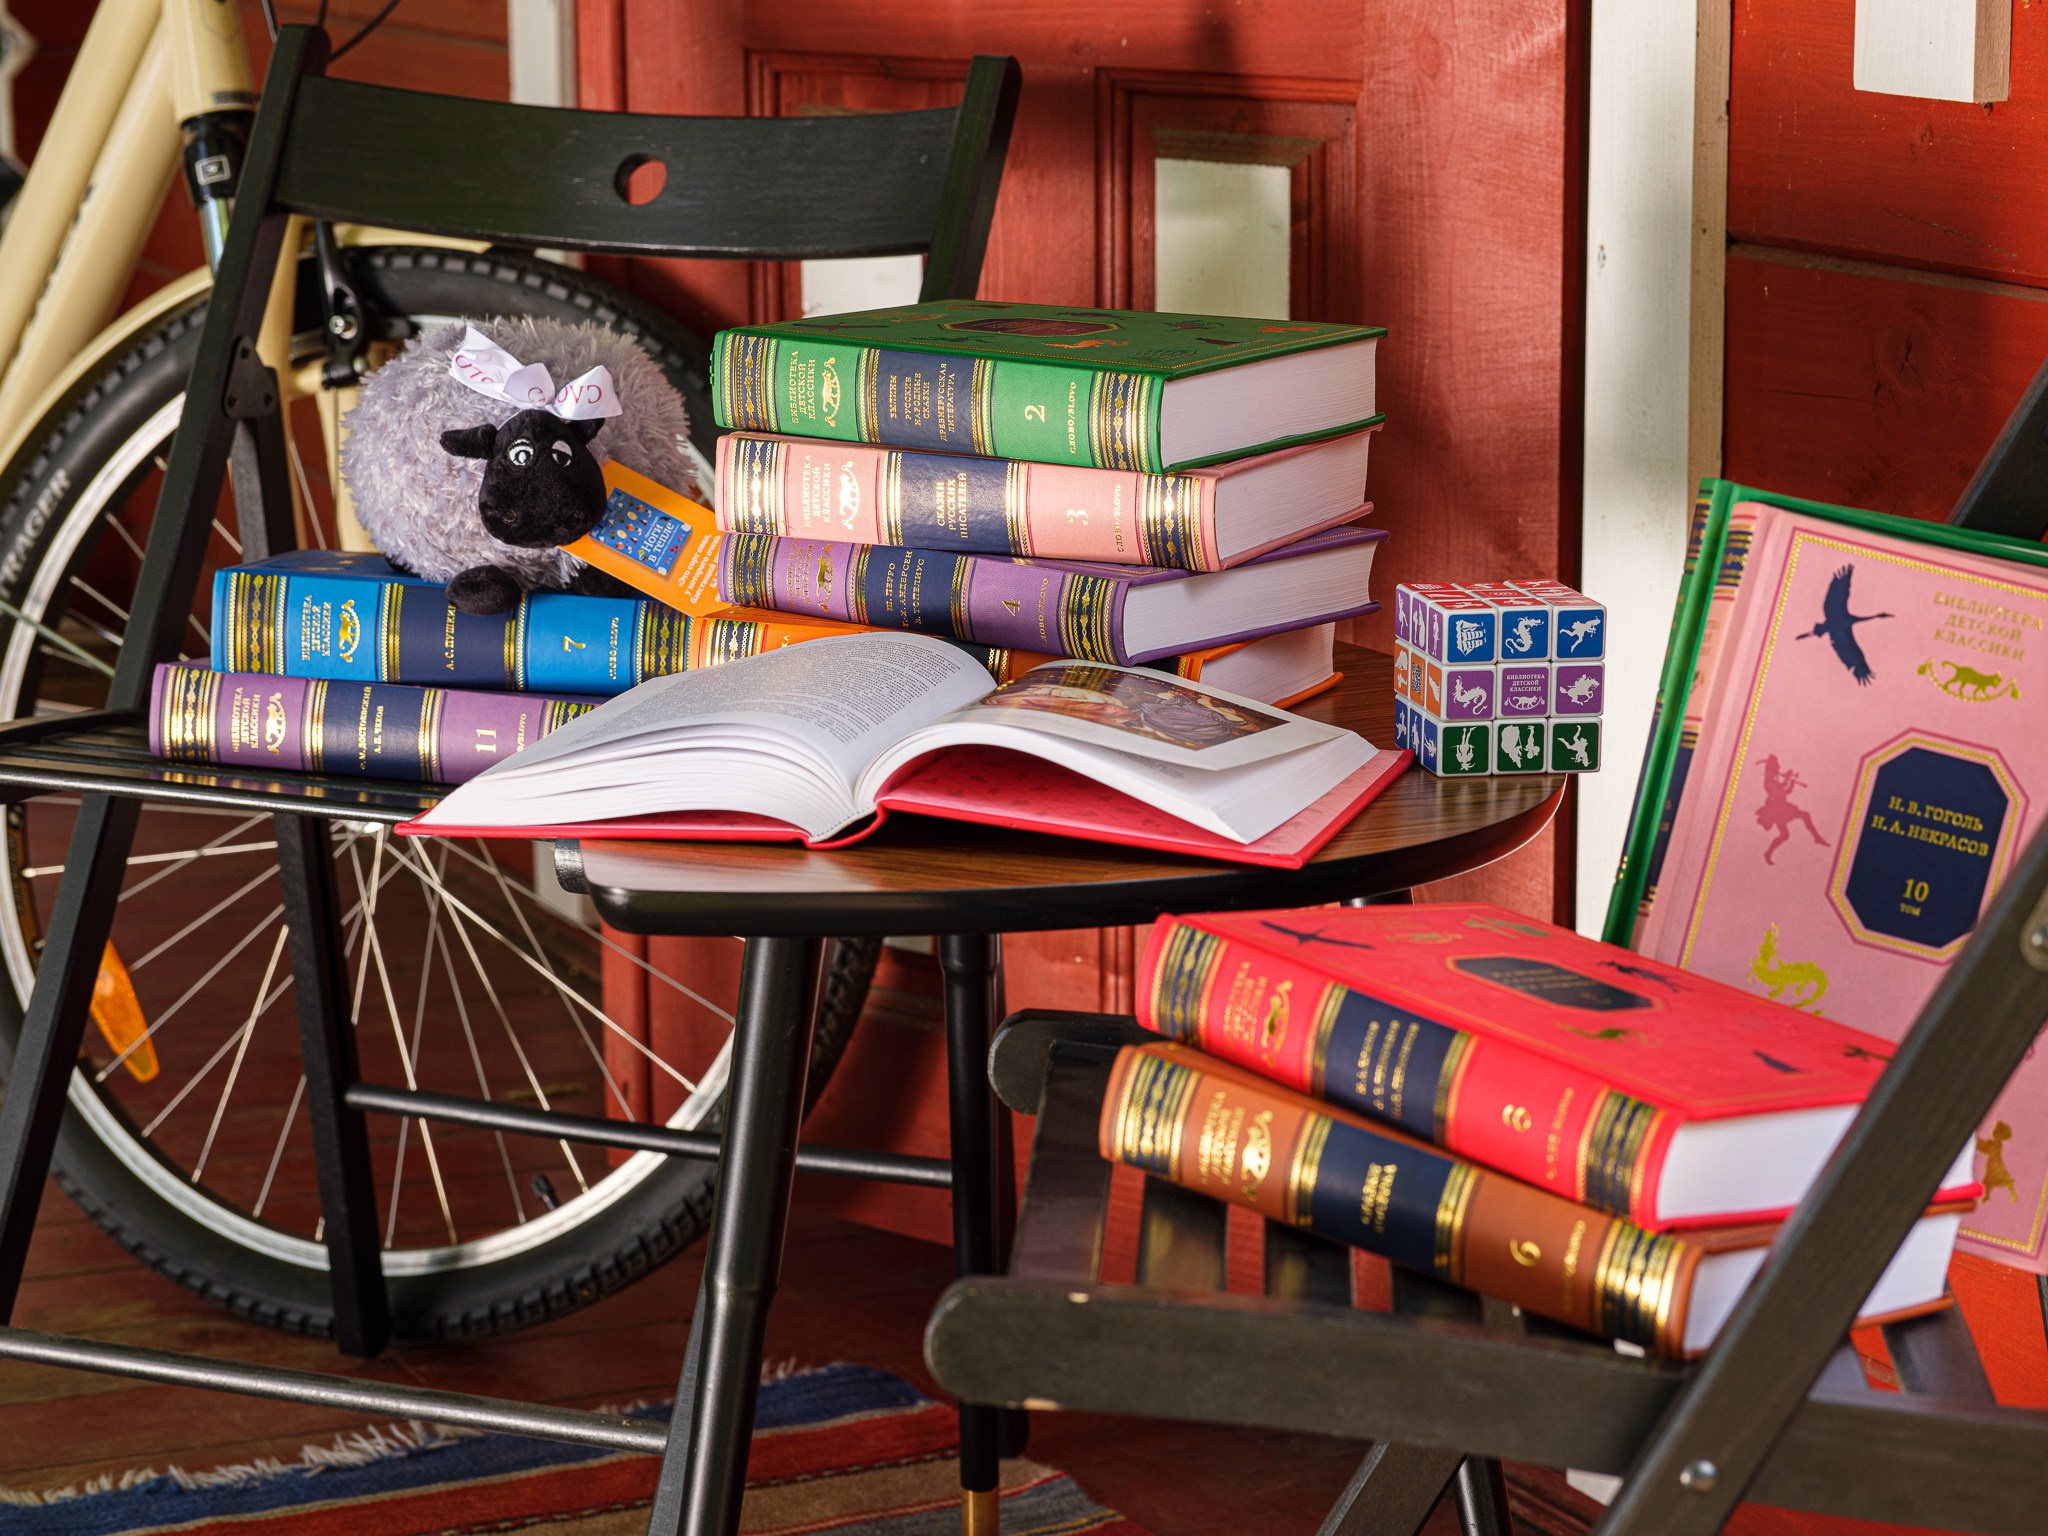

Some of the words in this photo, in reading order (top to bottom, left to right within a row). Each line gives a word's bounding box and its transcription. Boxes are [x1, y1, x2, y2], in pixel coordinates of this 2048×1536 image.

[789, 351, 798, 424] БИБЛИОТЕКА
[799, 364, 807, 415] ДЕТСКОЙ
[808, 358, 816, 420] КЛАССИКИ
[914, 372, 922, 426] НАРОДНЫЕ
[938, 363, 948, 441] ДРЕВНЕРУССКАЯ
[948, 373, 956, 433] ЛИТЕРАТУРА
[1024, 404, 1046, 423] 2
[803, 454, 812, 528] БИБЛИОТЕКА
[812, 466, 821, 519] ДЕТСКОЙ
[823, 463, 831, 523] КЛАССИКИ
[936, 481, 945, 527] СКАЗКИ
[948, 479, 957, 531] РУССКИХ
[958, 472, 968, 539] ПИСАТЕЛЕЙ
[641, 522, 664, 553] Ноги
[653, 522, 675, 554] тепле
[1066, 509, 1089, 526] 3
[886, 562, 896, 596] ПЕРРО
[899, 551, 912, 602] АНДЕРСЕН
[912, 558, 925, 614] ТОПЕЛИУС
[301, 595, 312, 661] БИБЛИОТЕКА
[311, 605, 321, 652] ДЕТСКОЙ
[322, 602, 331, 657] КЛАССИКИ
[1001, 598, 1021, 617] 4
[1933, 591, 2043, 631] БИБЛИОТЕКА
[1944, 613, 2022, 643] ДЕТСКОЙ
[562, 635, 586, 652] 7
[1935, 628, 2024, 661] КЛАССИКИ
[241, 697, 250, 745] ДЕТСКОЙ
[250, 694, 261, 749] КЛАССИКИ
[475, 728, 497, 753] 11
[1871, 815, 1887, 831] Н.
[1890, 820, 1905, 836] А.
[1908, 824, 1989, 857] НЕКРАСОВ
[1888, 796, 1904, 812] Н.
[1907, 801, 1921, 817] В.
[1924, 805, 1983, 832] ГОГОЛЬ
[1902, 878, 1929, 902] 10
